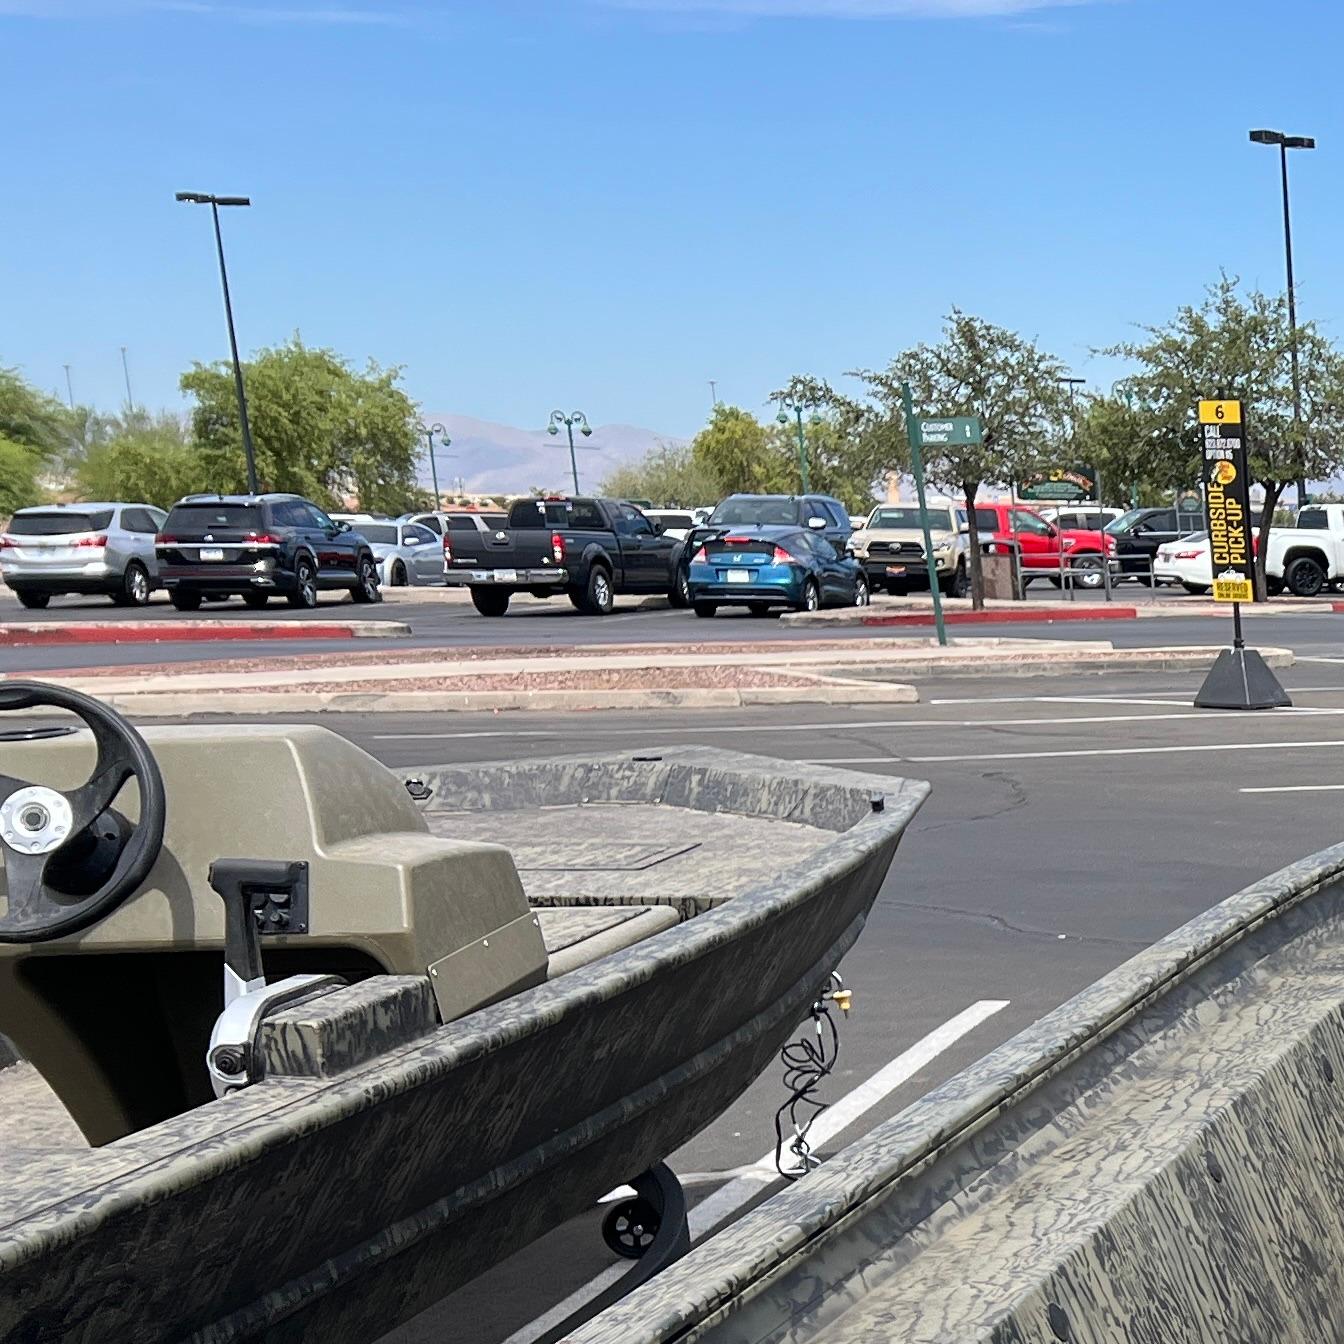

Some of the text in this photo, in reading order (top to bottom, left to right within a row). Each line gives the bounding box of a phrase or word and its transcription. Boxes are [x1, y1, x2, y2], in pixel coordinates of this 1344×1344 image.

[1215, 405, 1225, 419] 6
[1207, 483, 1229, 564] CURBSIDE
[1226, 498, 1247, 564] PICK-UP
[1216, 582, 1248, 592] RESERVED
